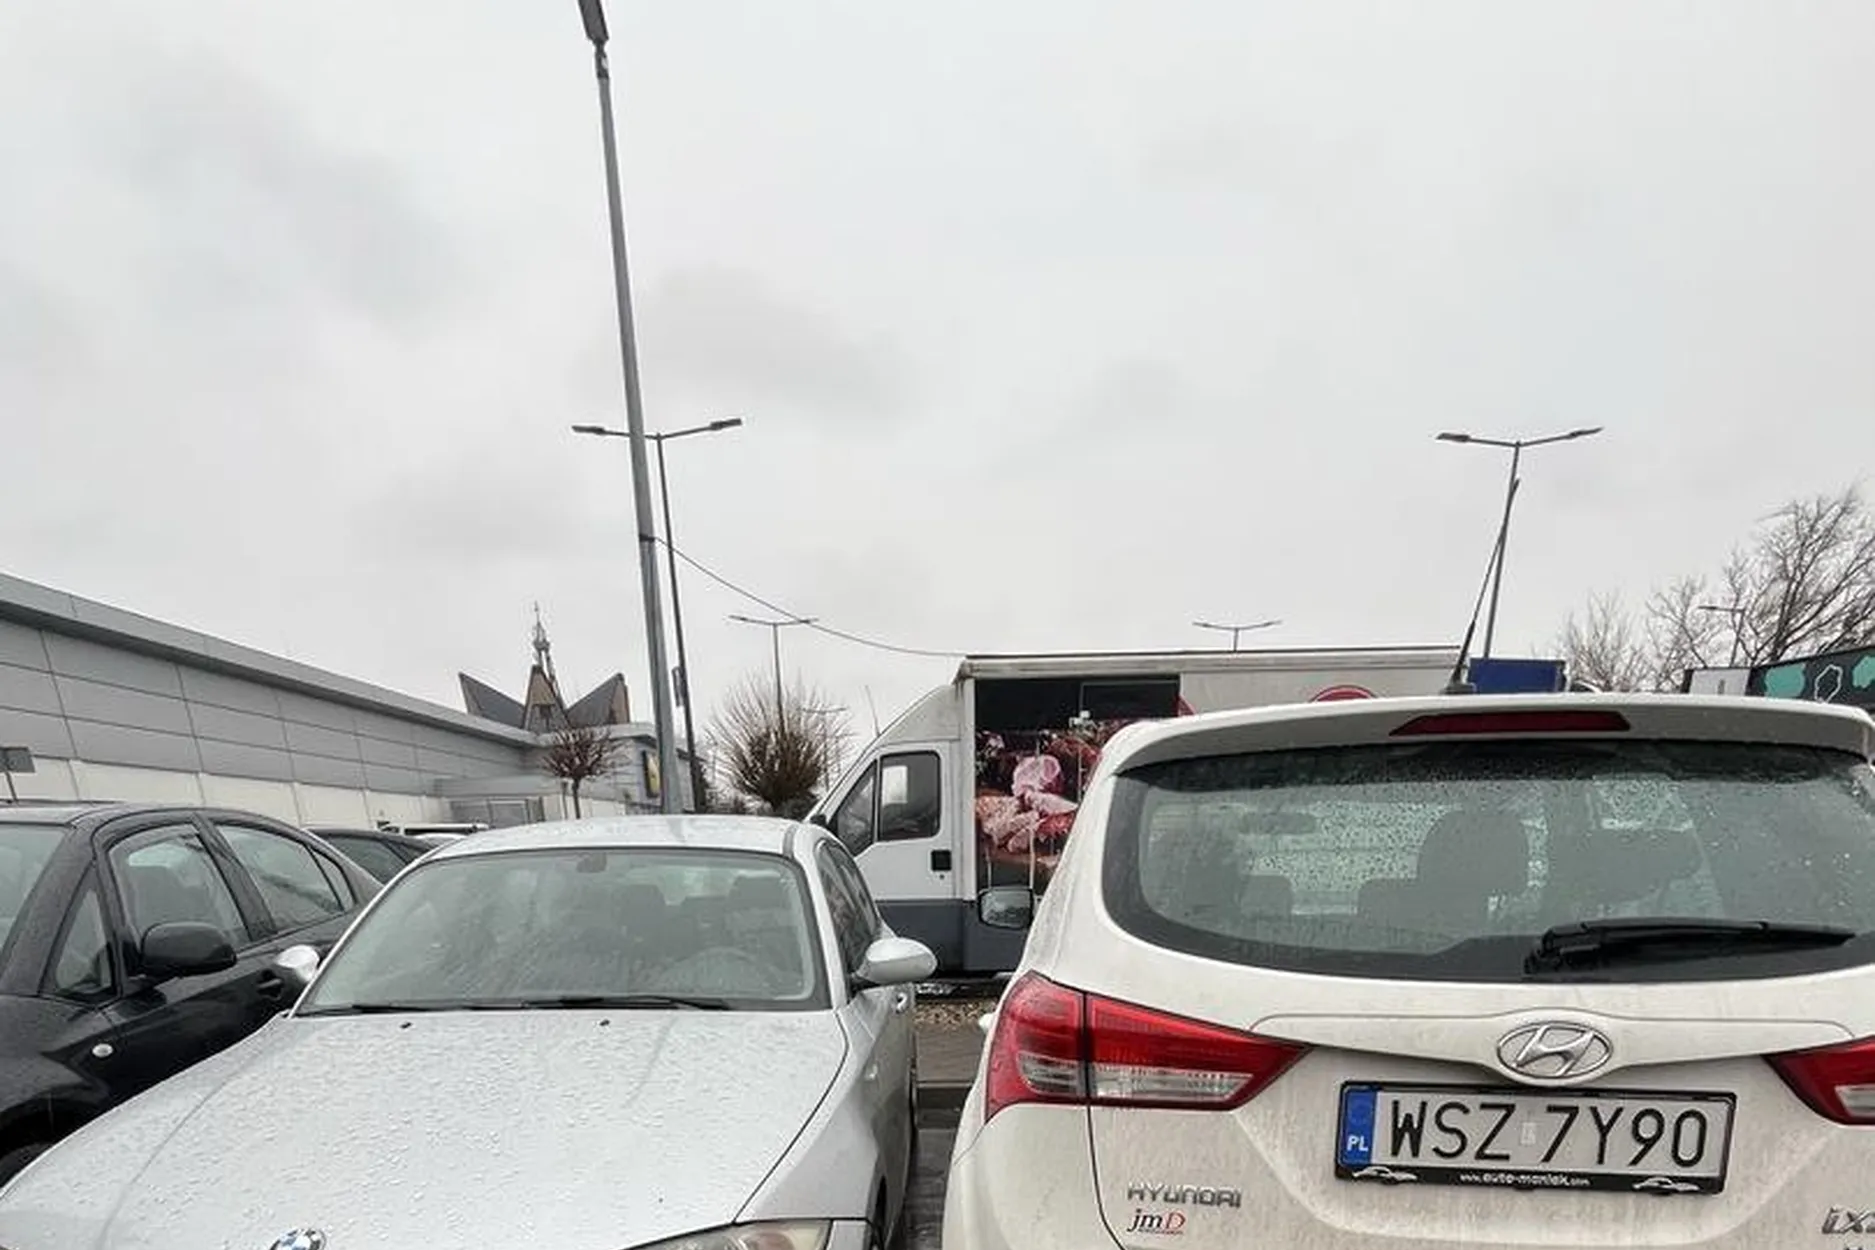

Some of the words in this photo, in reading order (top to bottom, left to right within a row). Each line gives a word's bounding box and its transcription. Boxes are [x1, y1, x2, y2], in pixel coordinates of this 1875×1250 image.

[1346, 1136, 1369, 1151] PL
[1389, 1100, 1516, 1160] WSZ
[1541, 1104, 1707, 1167] 7Y90
[1127, 1182, 1241, 1208] HYUNDAI
